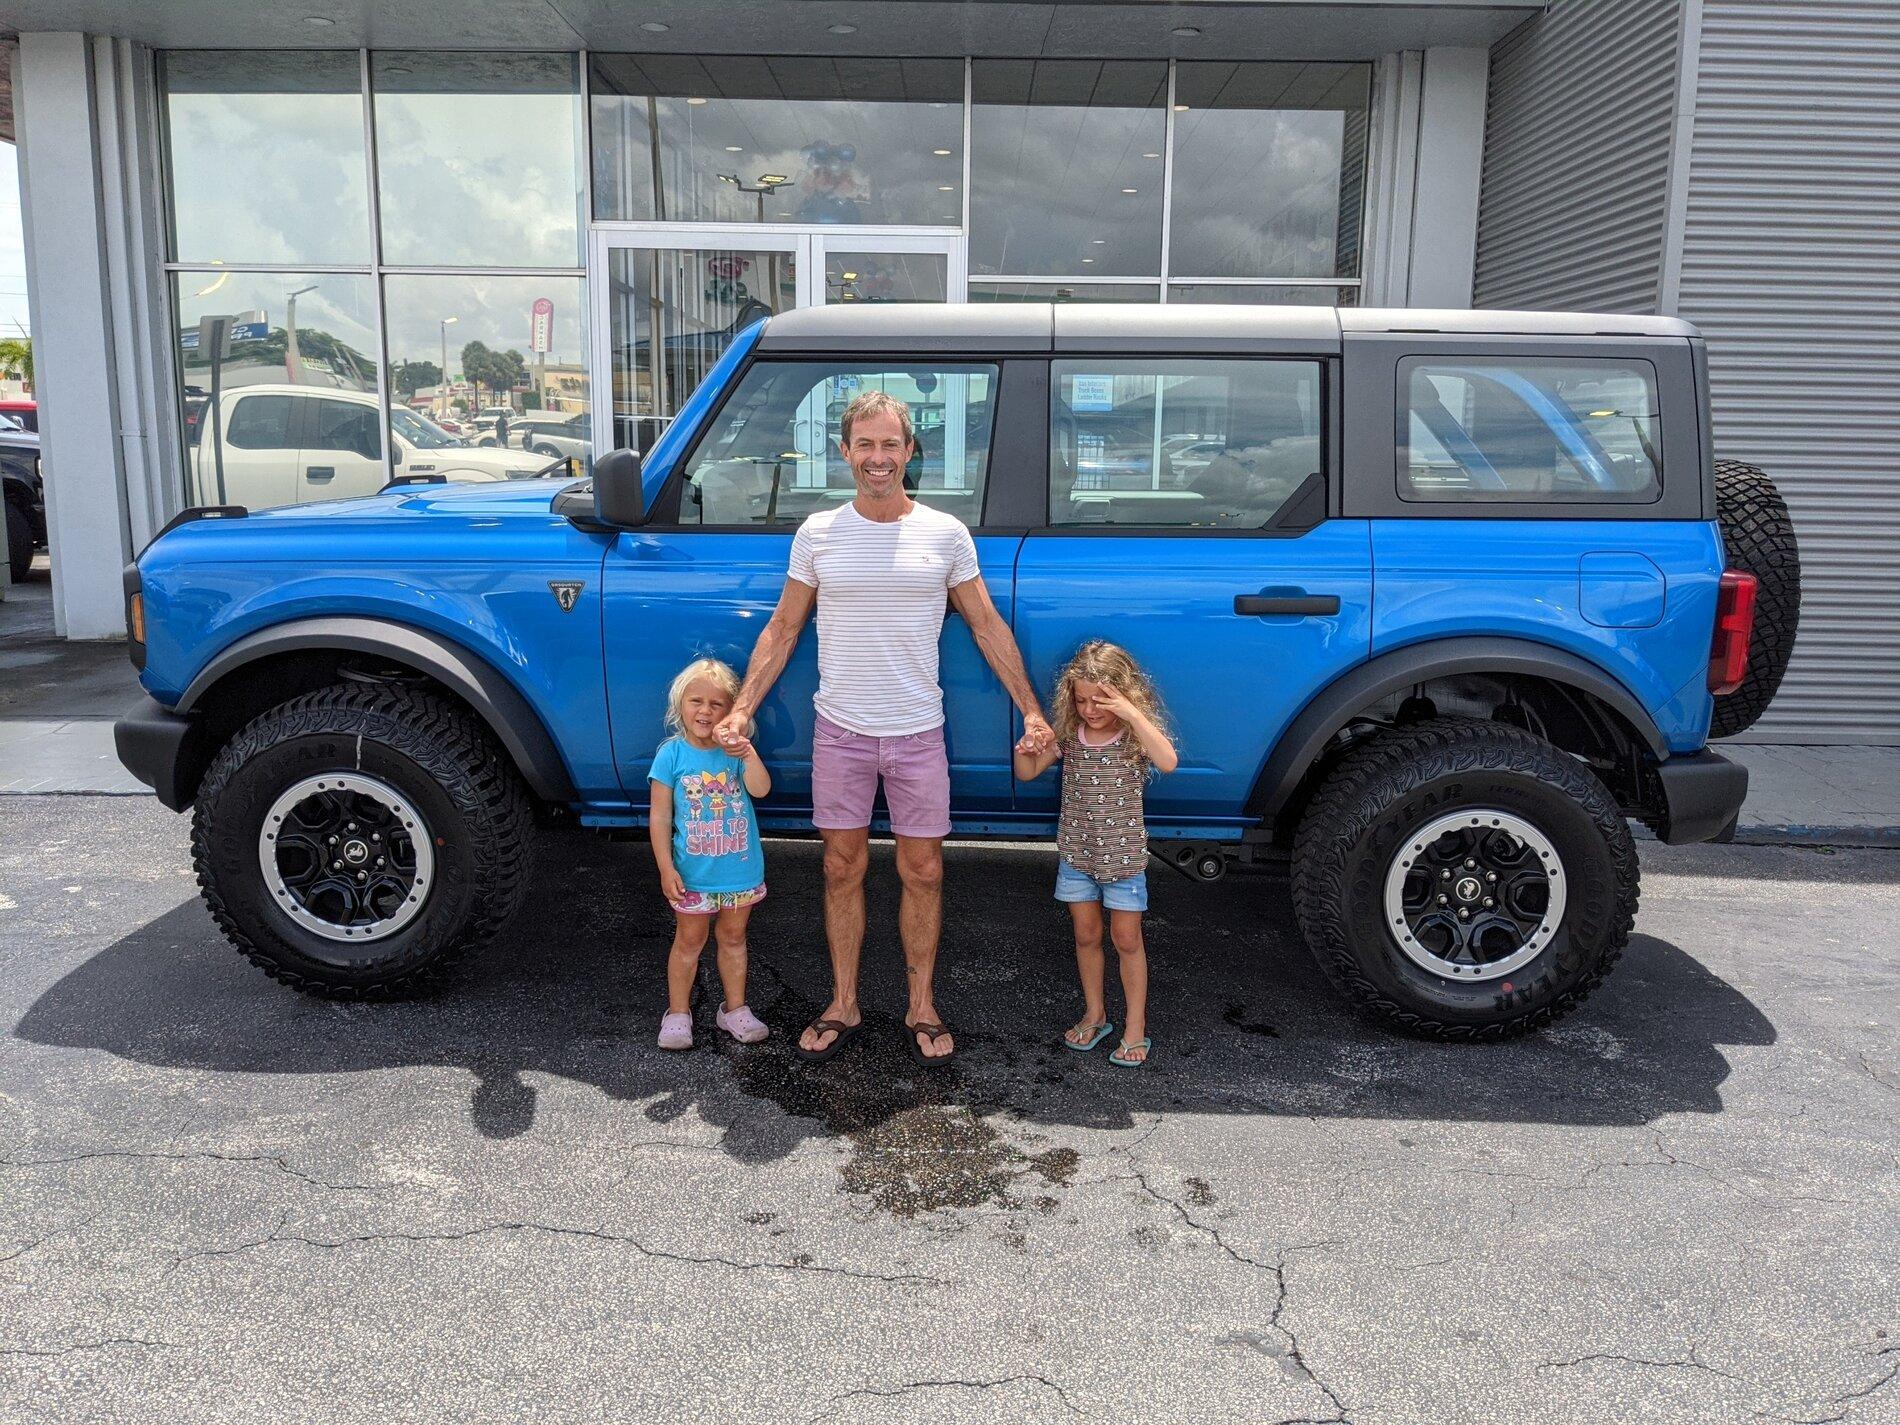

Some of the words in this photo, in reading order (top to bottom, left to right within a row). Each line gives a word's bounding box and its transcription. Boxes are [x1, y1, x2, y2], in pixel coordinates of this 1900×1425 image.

[685, 820, 723, 836] TIME
[727, 817, 748, 834] TO
[686, 832, 748, 856] SHINE
